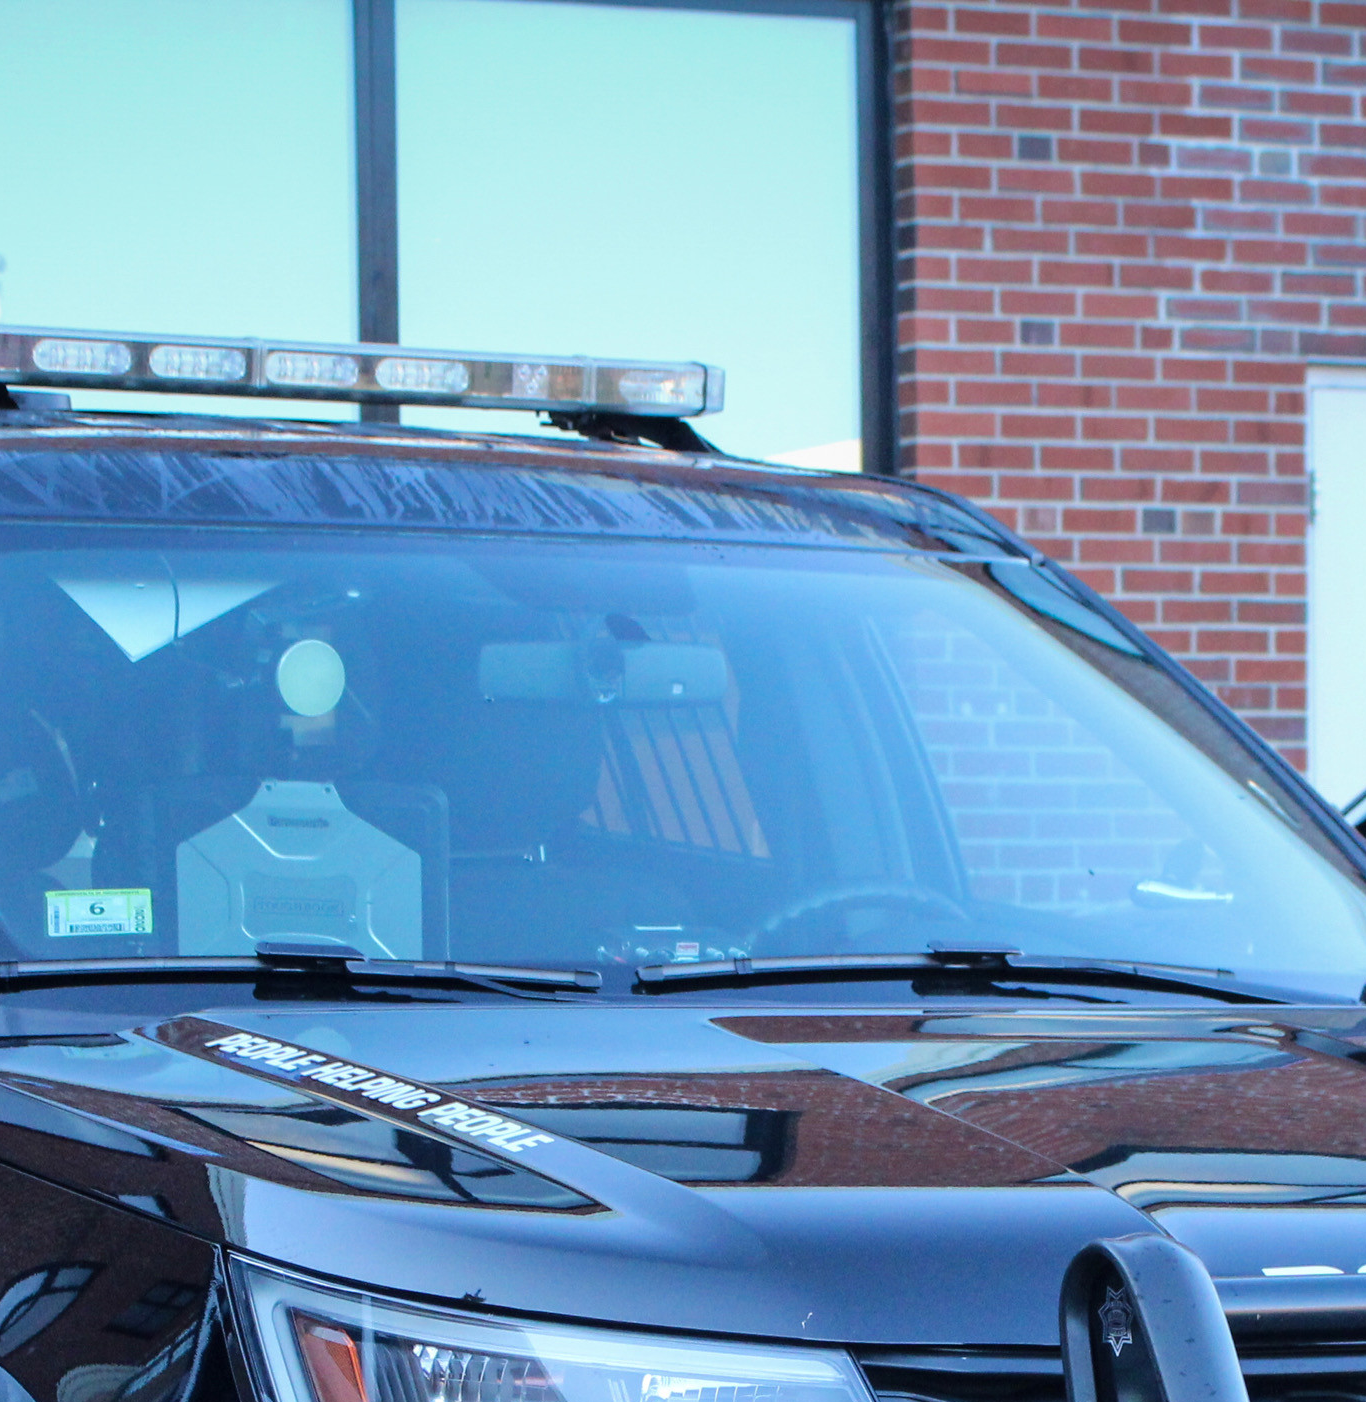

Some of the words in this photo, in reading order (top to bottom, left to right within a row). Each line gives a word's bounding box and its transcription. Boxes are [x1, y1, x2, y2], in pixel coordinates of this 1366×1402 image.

[89, 901, 106, 917] 6
[204, 1032, 327, 1072] PEOPLE
[300, 1061, 442, 1110] HELPING
[418, 1101, 555, 1153] PEOPLE
